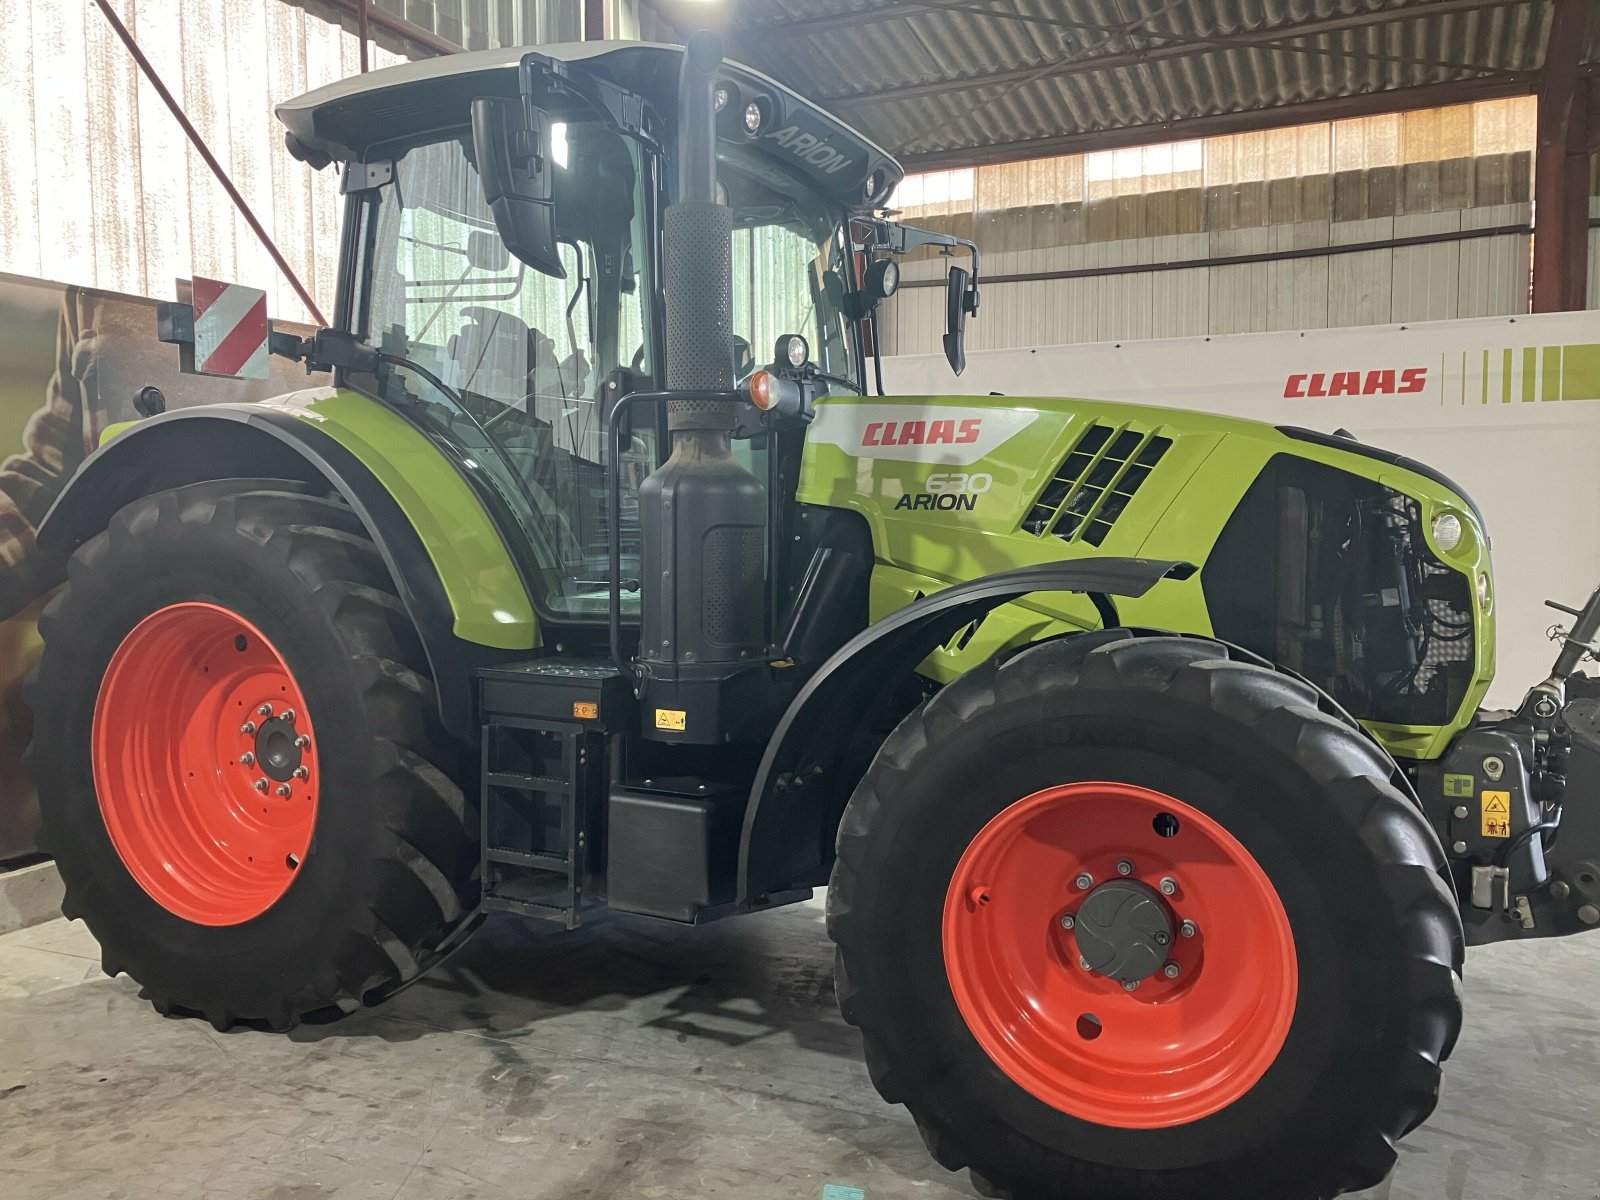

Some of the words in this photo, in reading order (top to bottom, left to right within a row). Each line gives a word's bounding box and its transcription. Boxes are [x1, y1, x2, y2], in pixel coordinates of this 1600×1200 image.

[764, 125, 852, 174] ARION
[1283, 368, 1428, 398] CLAAS
[862, 419, 982, 446] CLAAS
[925, 473, 993, 494] 630
[894, 493, 978, 511] ARION
